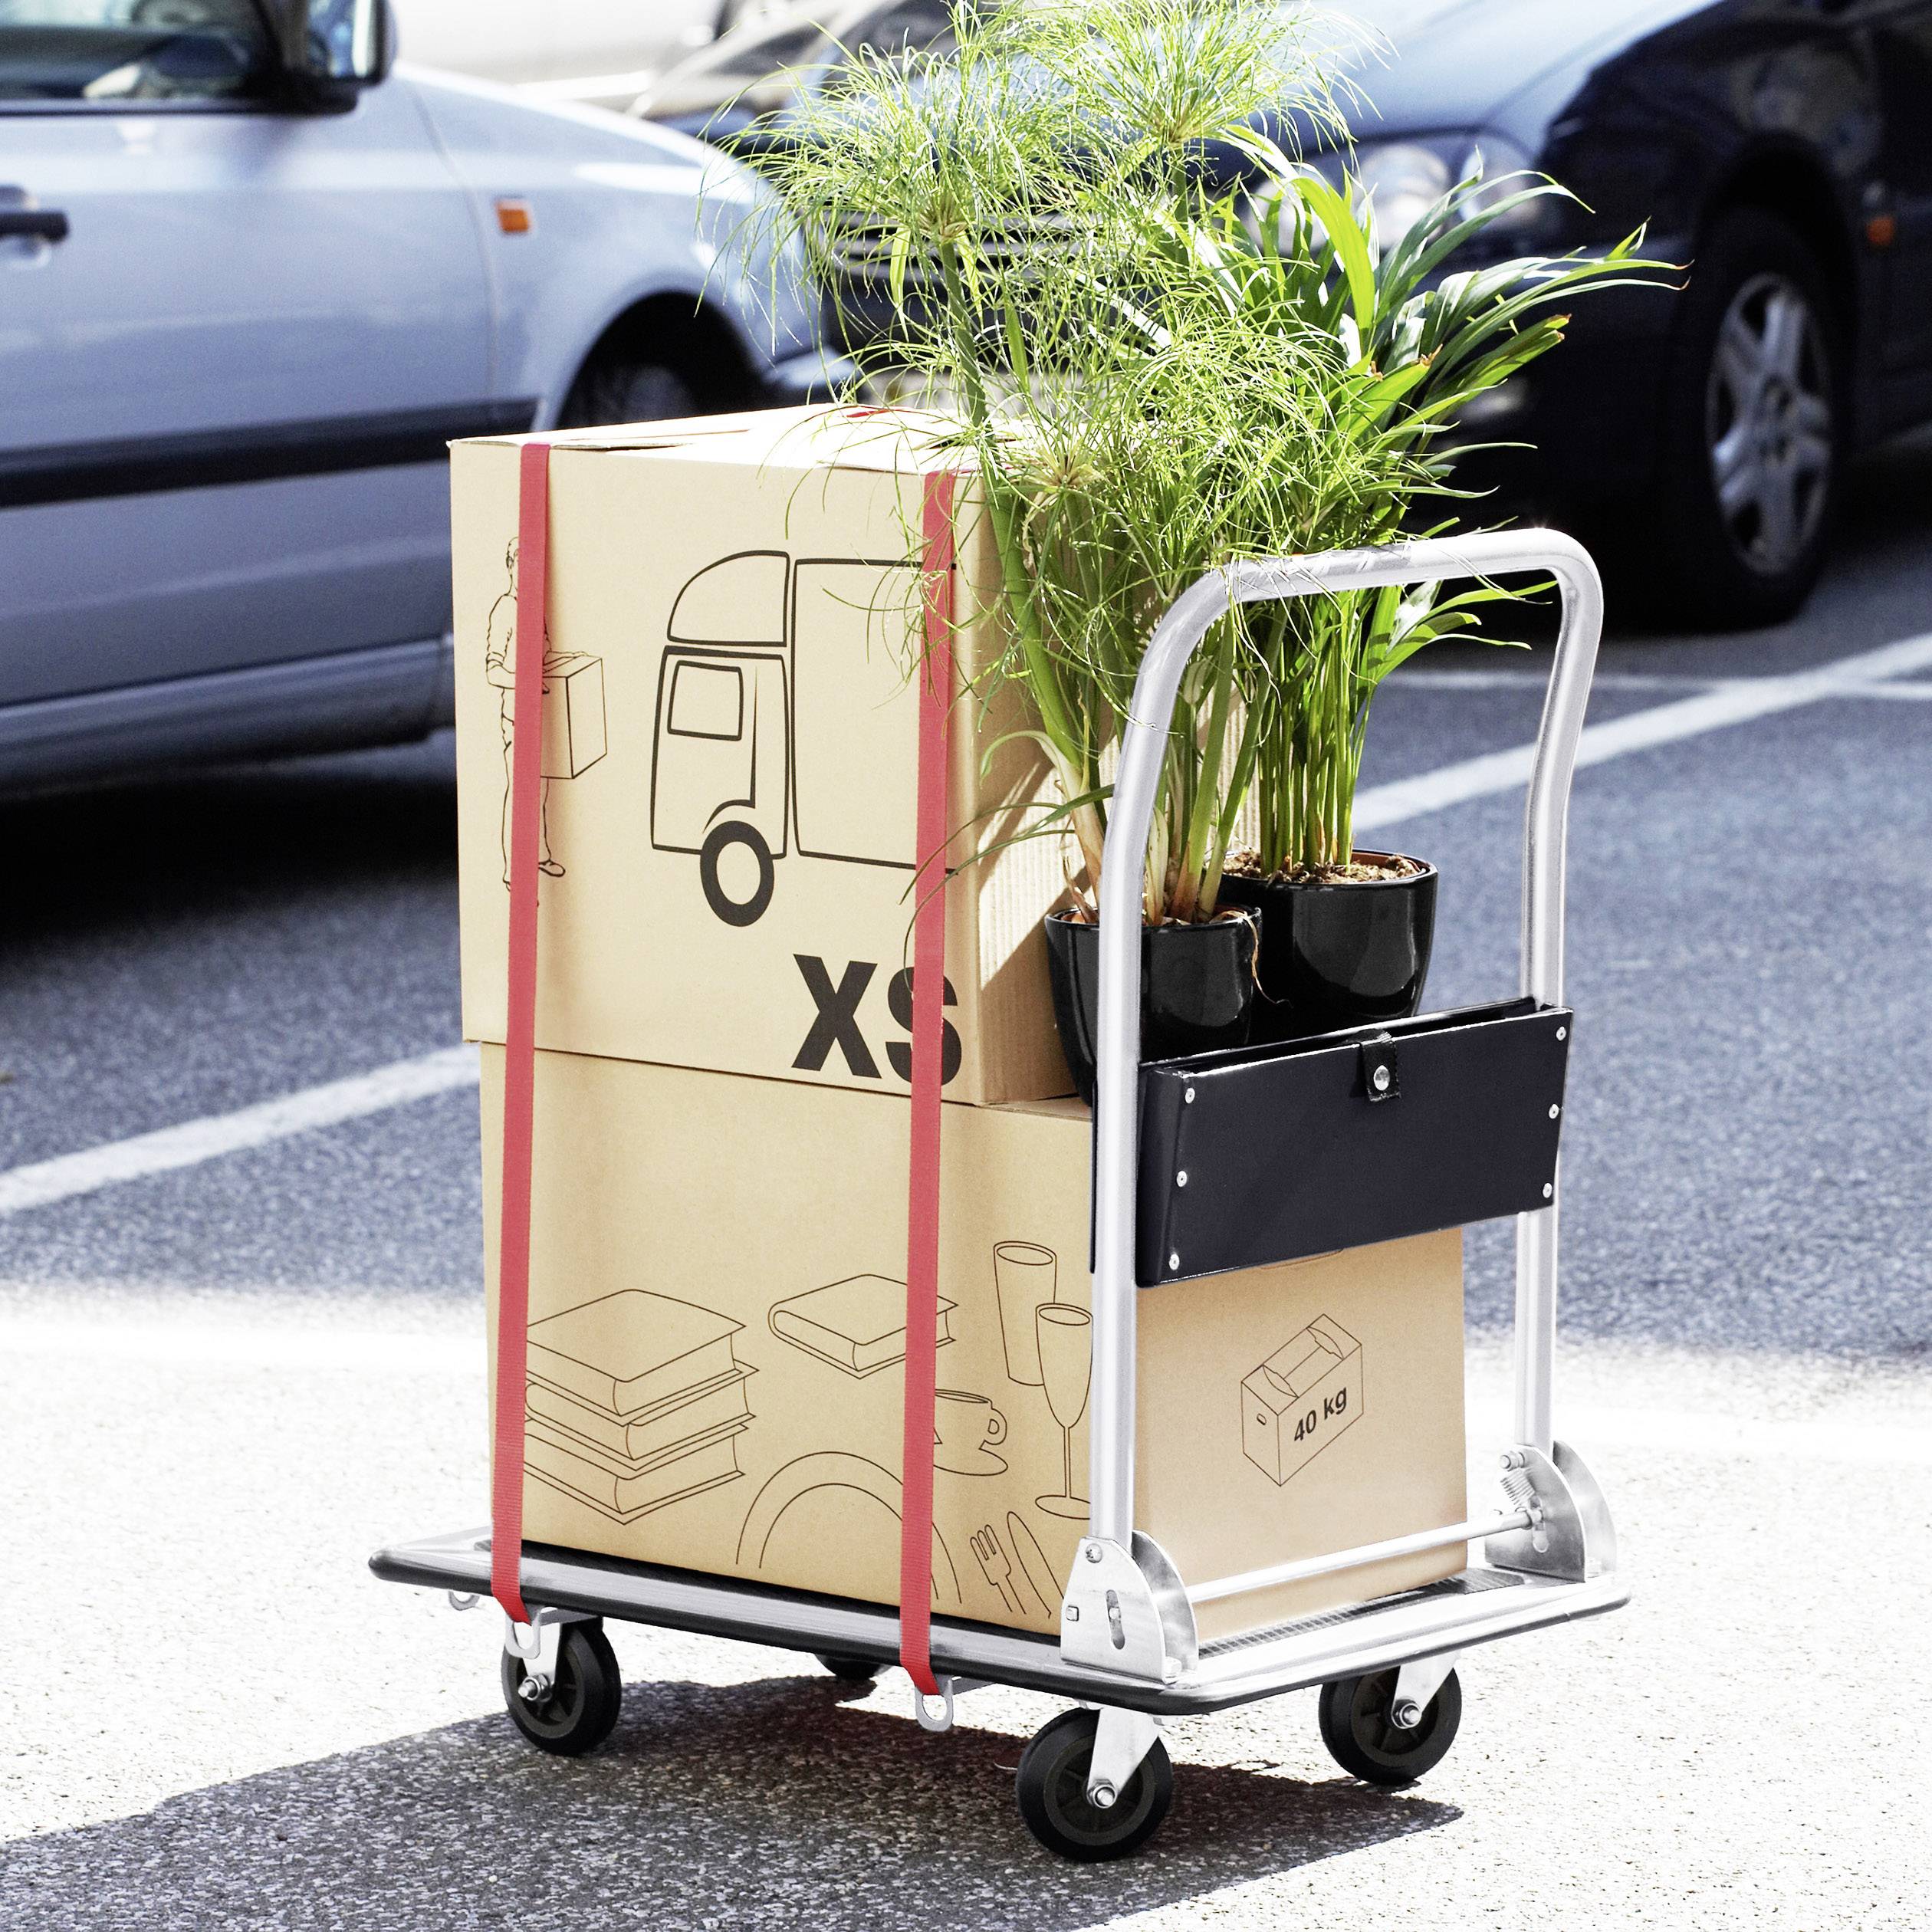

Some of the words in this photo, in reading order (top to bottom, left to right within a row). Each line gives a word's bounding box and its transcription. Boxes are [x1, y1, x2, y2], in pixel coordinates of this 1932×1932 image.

[791, 954, 962, 1086] XS
[1294, 1410, 1316, 1441] 40
[1323, 1387, 1347, 1420] kg
